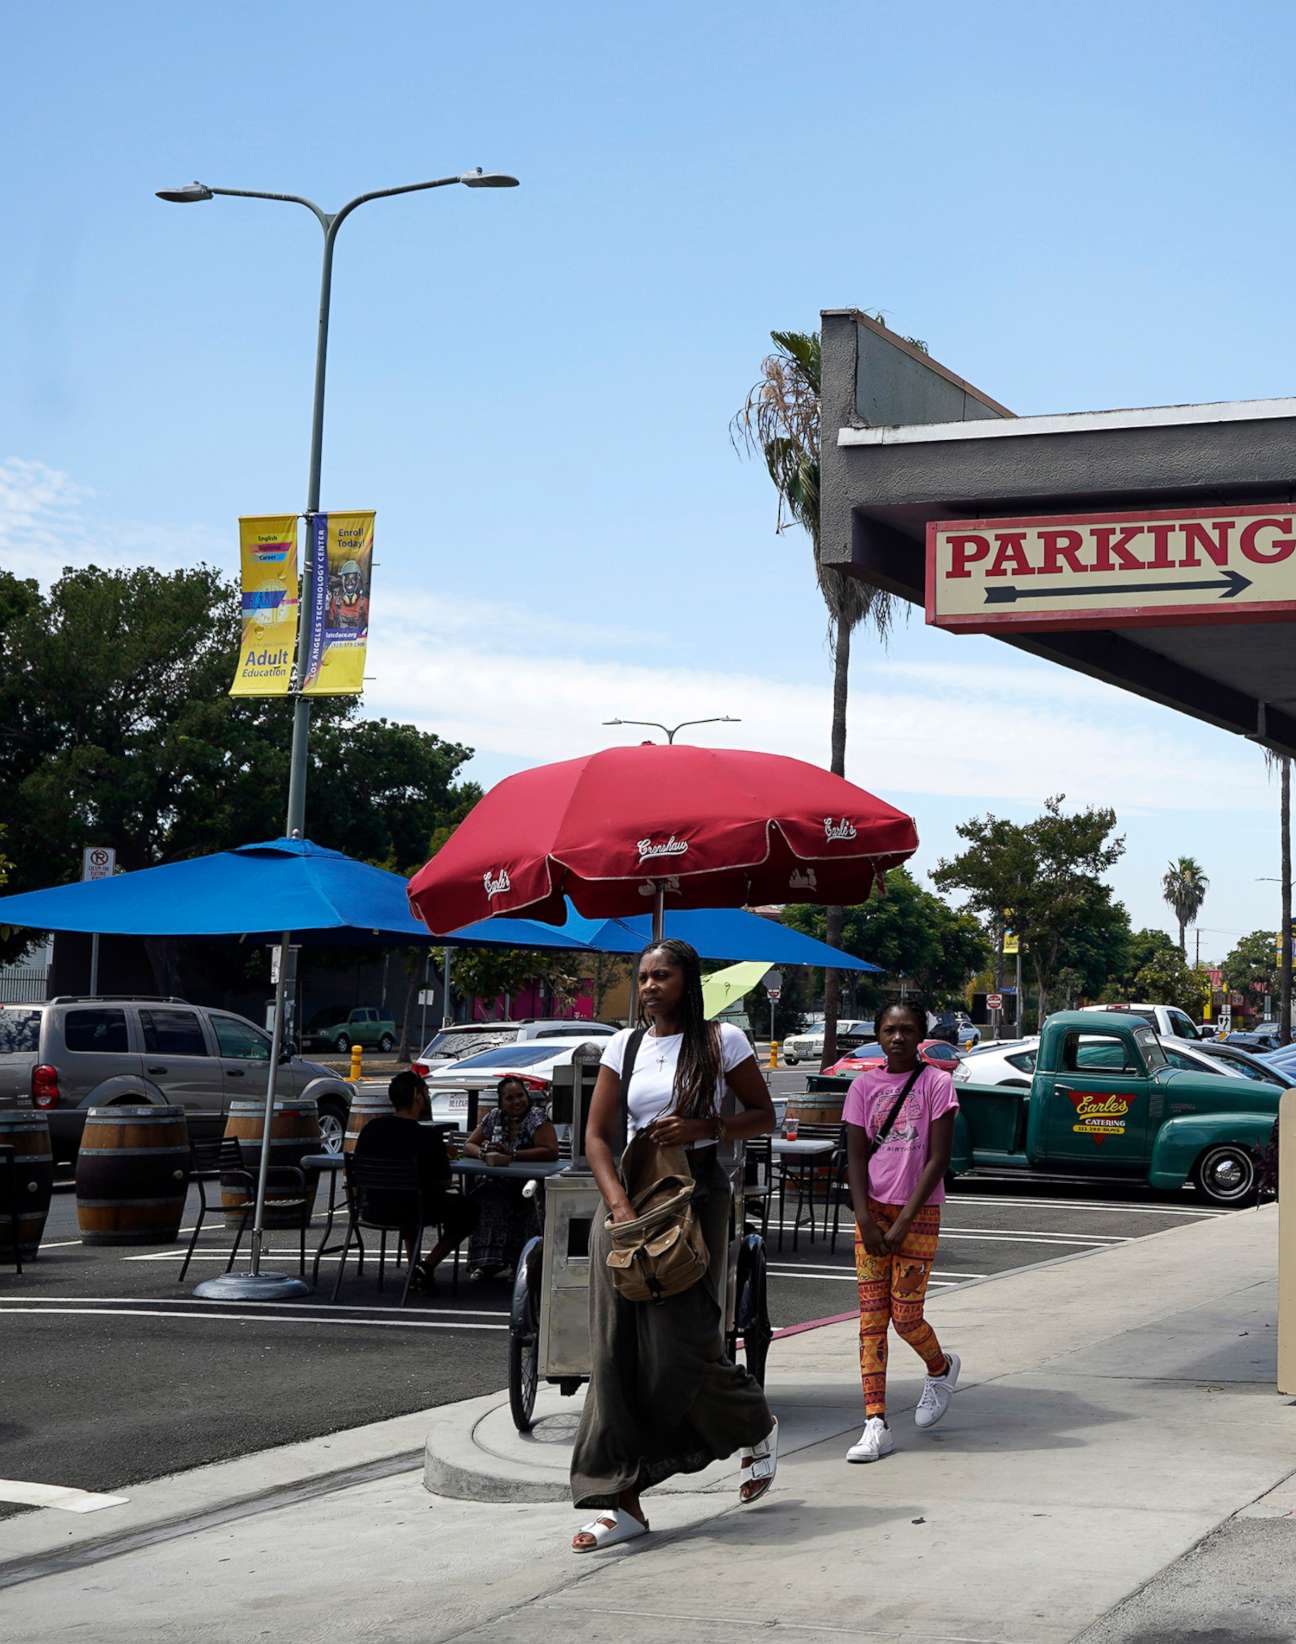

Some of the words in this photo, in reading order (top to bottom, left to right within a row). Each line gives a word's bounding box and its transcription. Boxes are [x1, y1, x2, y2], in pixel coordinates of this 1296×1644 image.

[338, 528, 364, 537] Enroll
[317, 529, 325, 562] CENTER
[338, 540, 365, 549] Today!
[945, 518, 1296, 579] PARKING
[316, 564, 324, 620] TECHNOLOGY
[312, 622, 322, 660] ANGELES
[245, 649, 289, 666] Adult
[242, 668, 286, 678] Education
[310, 662, 318, 678] LOS
[637, 835, 688, 864] Crenshaw
[1077, 1094, 1129, 1120] Earle's
[1085, 1119, 1126, 1127] CATERING
